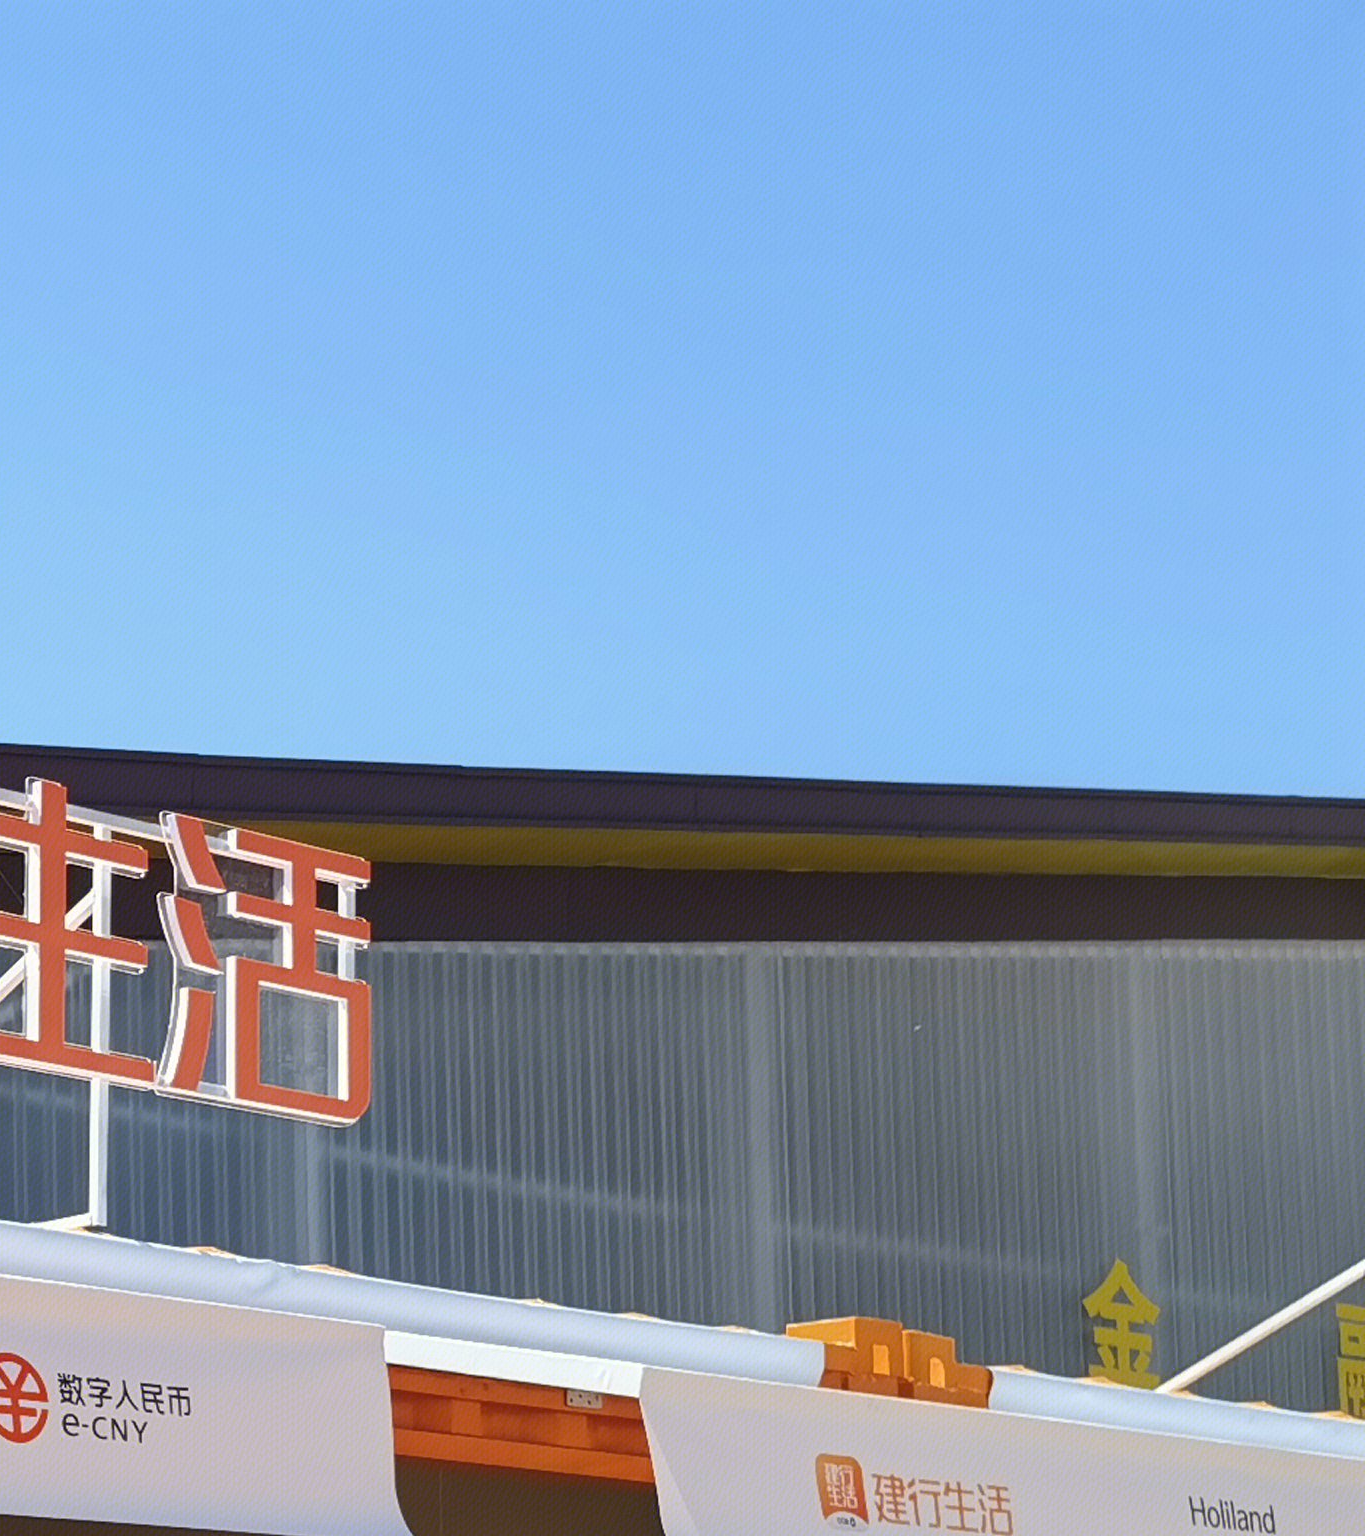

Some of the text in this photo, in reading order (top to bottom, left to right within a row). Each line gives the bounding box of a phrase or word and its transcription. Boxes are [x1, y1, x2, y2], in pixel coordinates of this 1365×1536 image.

[1082, 1258, 1160, 1389] 金
[57, 1372, 192, 1417] 数字人民币
[61, 1412, 148, 1444] e-CNY
[871, 1474, 1013, 1536] 建行生活
[1188, 1495, 1276, 1535] Holiland
